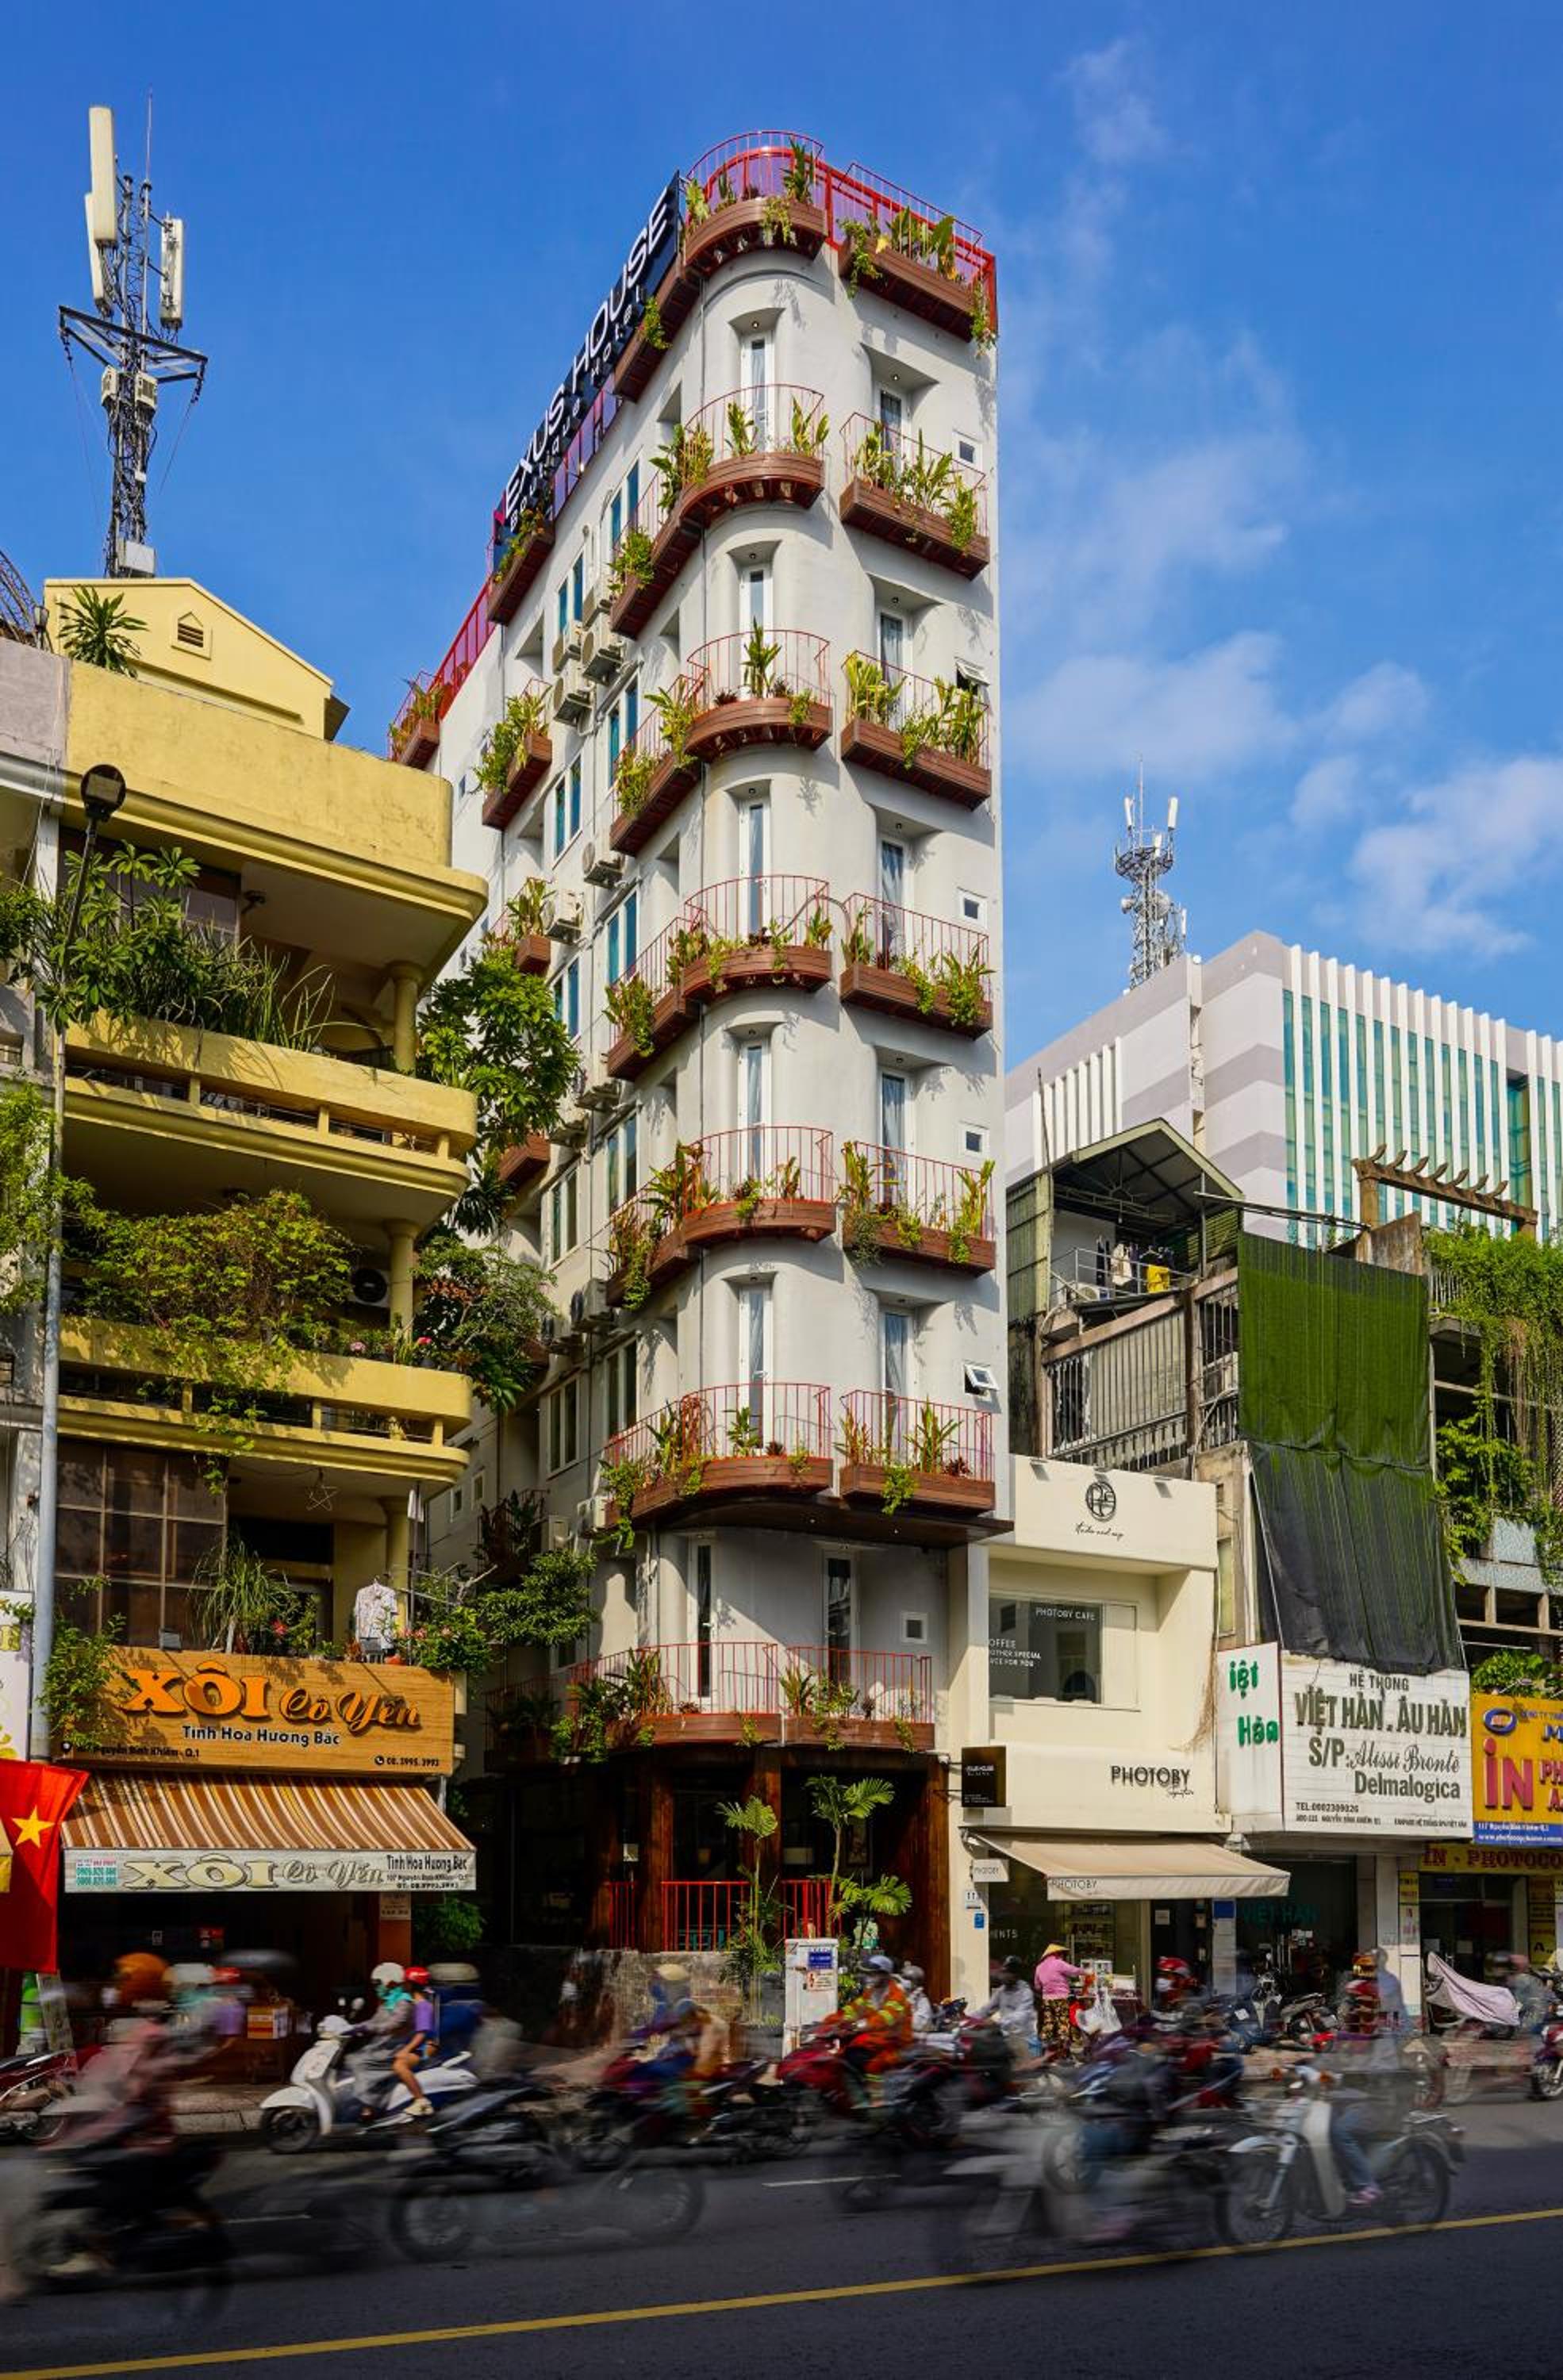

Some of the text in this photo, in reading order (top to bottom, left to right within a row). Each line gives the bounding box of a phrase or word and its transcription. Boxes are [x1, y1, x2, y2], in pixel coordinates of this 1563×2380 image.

[573, 186, 667, 393] HOUSE
[1035, 1607, 1096, 1621] PHOTOBY CAFE
[122, 1660, 270, 1718] XÔI
[1342, 1691, 1384, 1732] HÀN
[1427, 1699, 1467, 1738] HÀN
[221, 1726, 252, 1741] Hoa
[1238, 1715, 1279, 1748] Hàn
[1111, 1765, 1191, 1787] PHOTOBY
[1354, 1770, 1461, 1803] Delmalogica
[123, 1853, 278, 1890] XÔI
